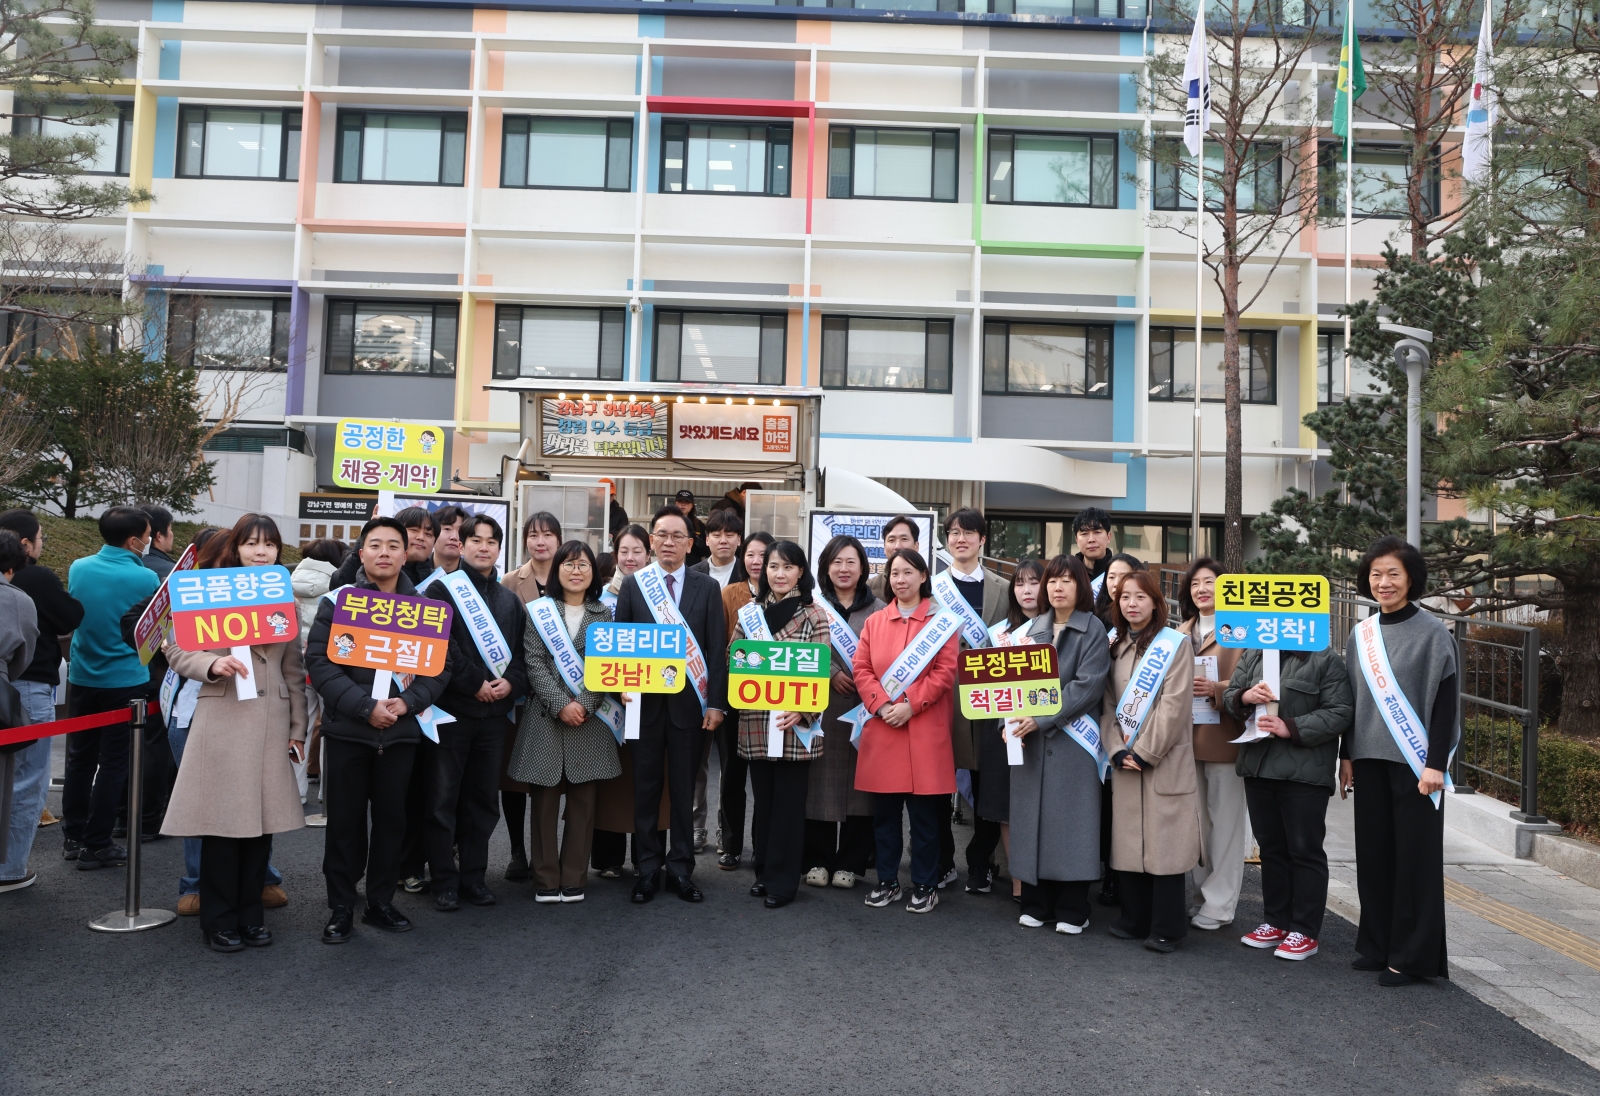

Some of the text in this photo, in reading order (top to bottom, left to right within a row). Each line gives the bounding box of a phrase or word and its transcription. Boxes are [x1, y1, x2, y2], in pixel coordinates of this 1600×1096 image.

[557, 402, 597, 417] 강남구
[765, 417, 789, 430] 출출
[342, 424, 406, 451] 공정한
[557, 418, 653, 436] 청렴 우수 등급
[679, 424, 760, 441] 맛있게드세요
[765, 431, 789, 444] 하면
[546, 433, 664, 455] 여러분 덕분입니다
[340, 459, 438, 489] 채용·계약!
[177, 571, 286, 605] 금품향응
[639, 567, 666, 606] 청렴
[1221, 580, 1322, 608] 친절공정
[194, 611, 261, 644] NO!
[341, 593, 448, 634] 부정청탁
[455, 584, 505, 664] 청렴동호회
[742, 602, 763, 633] 청렴
[592, 627, 681, 654] 청렴리더
[1255, 617, 1316, 645] 정착!
[364, 634, 434, 669] 근절!
[768, 646, 820, 673] 갑질
[892, 616, 952, 683] 청렴동호회
[964, 648, 1052, 679] 부정부패
[600, 662, 652, 687] 강남!
[1135, 646, 1171, 693] 청렴
[738, 679, 819, 707] OUT!
[969, 687, 1023, 714] 척결!
